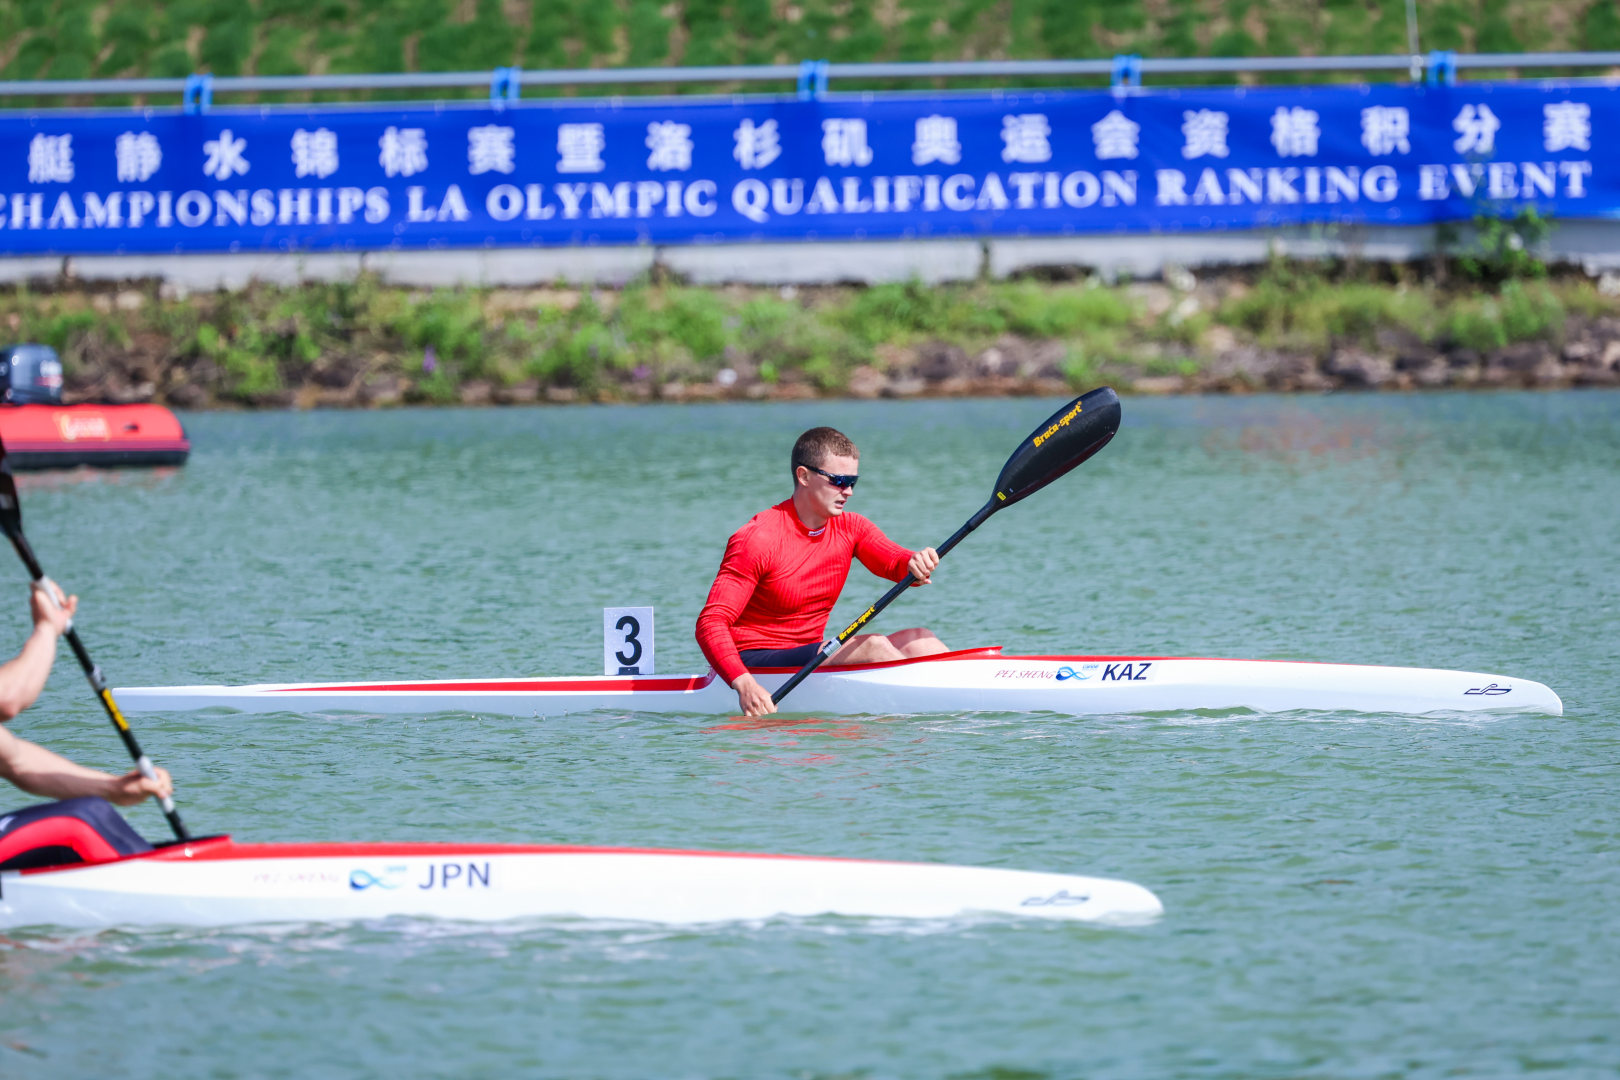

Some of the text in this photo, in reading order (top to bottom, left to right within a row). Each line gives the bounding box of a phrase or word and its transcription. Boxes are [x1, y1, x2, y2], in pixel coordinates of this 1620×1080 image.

[0, 160, 1593, 229] HAMPIONSHIPS LA OLYMPIC QUALIFICATION RANKING EVENT
[615, 615, 642, 666] 3
[1017, 669, 1055, 680] SHENG
[1101, 663, 1152, 681] KAZ
[418, 862, 491, 890] JPN
